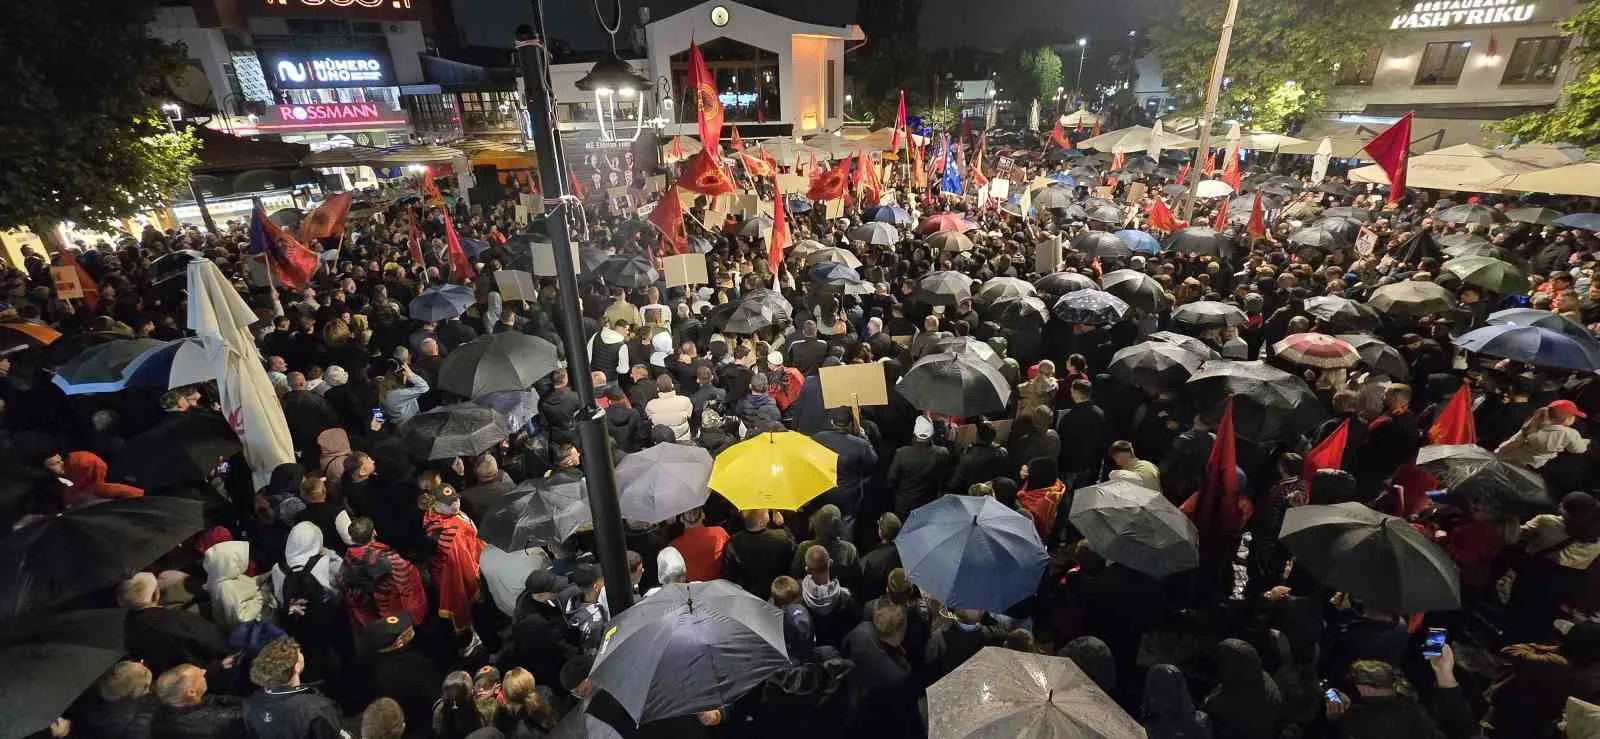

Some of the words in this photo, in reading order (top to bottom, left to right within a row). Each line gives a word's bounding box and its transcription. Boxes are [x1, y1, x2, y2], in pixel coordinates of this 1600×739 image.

[1390, 4, 1536, 30] PASHTRIKU
[317, 71, 351, 82] UNO
[280, 104, 379, 121] ROSSMANN
